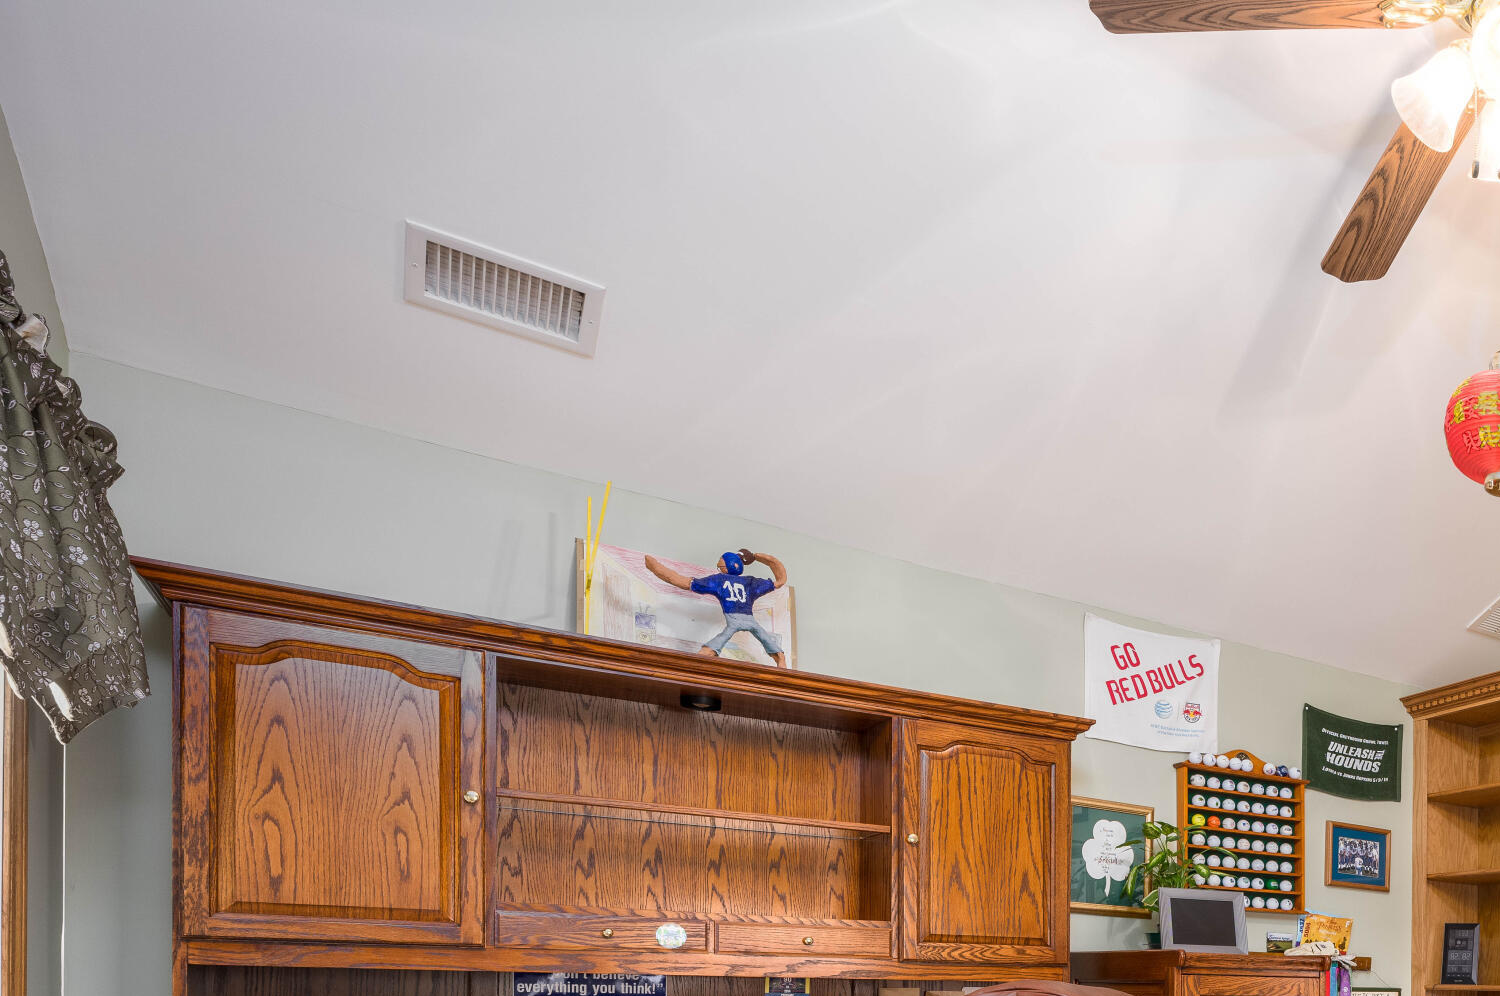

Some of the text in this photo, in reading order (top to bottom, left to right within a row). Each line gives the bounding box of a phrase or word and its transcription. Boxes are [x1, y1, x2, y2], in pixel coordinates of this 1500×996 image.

[723, 581, 747, 603] 10
[1110, 642, 1141, 671] GO
[1105, 654, 1204, 706] RED BULLS
[1327, 741, 1376, 760] UNLEASH
[1326, 752, 1381, 773] HOUNDS
[516, 982, 588, 995] everything
[592, 984, 616, 995] you
